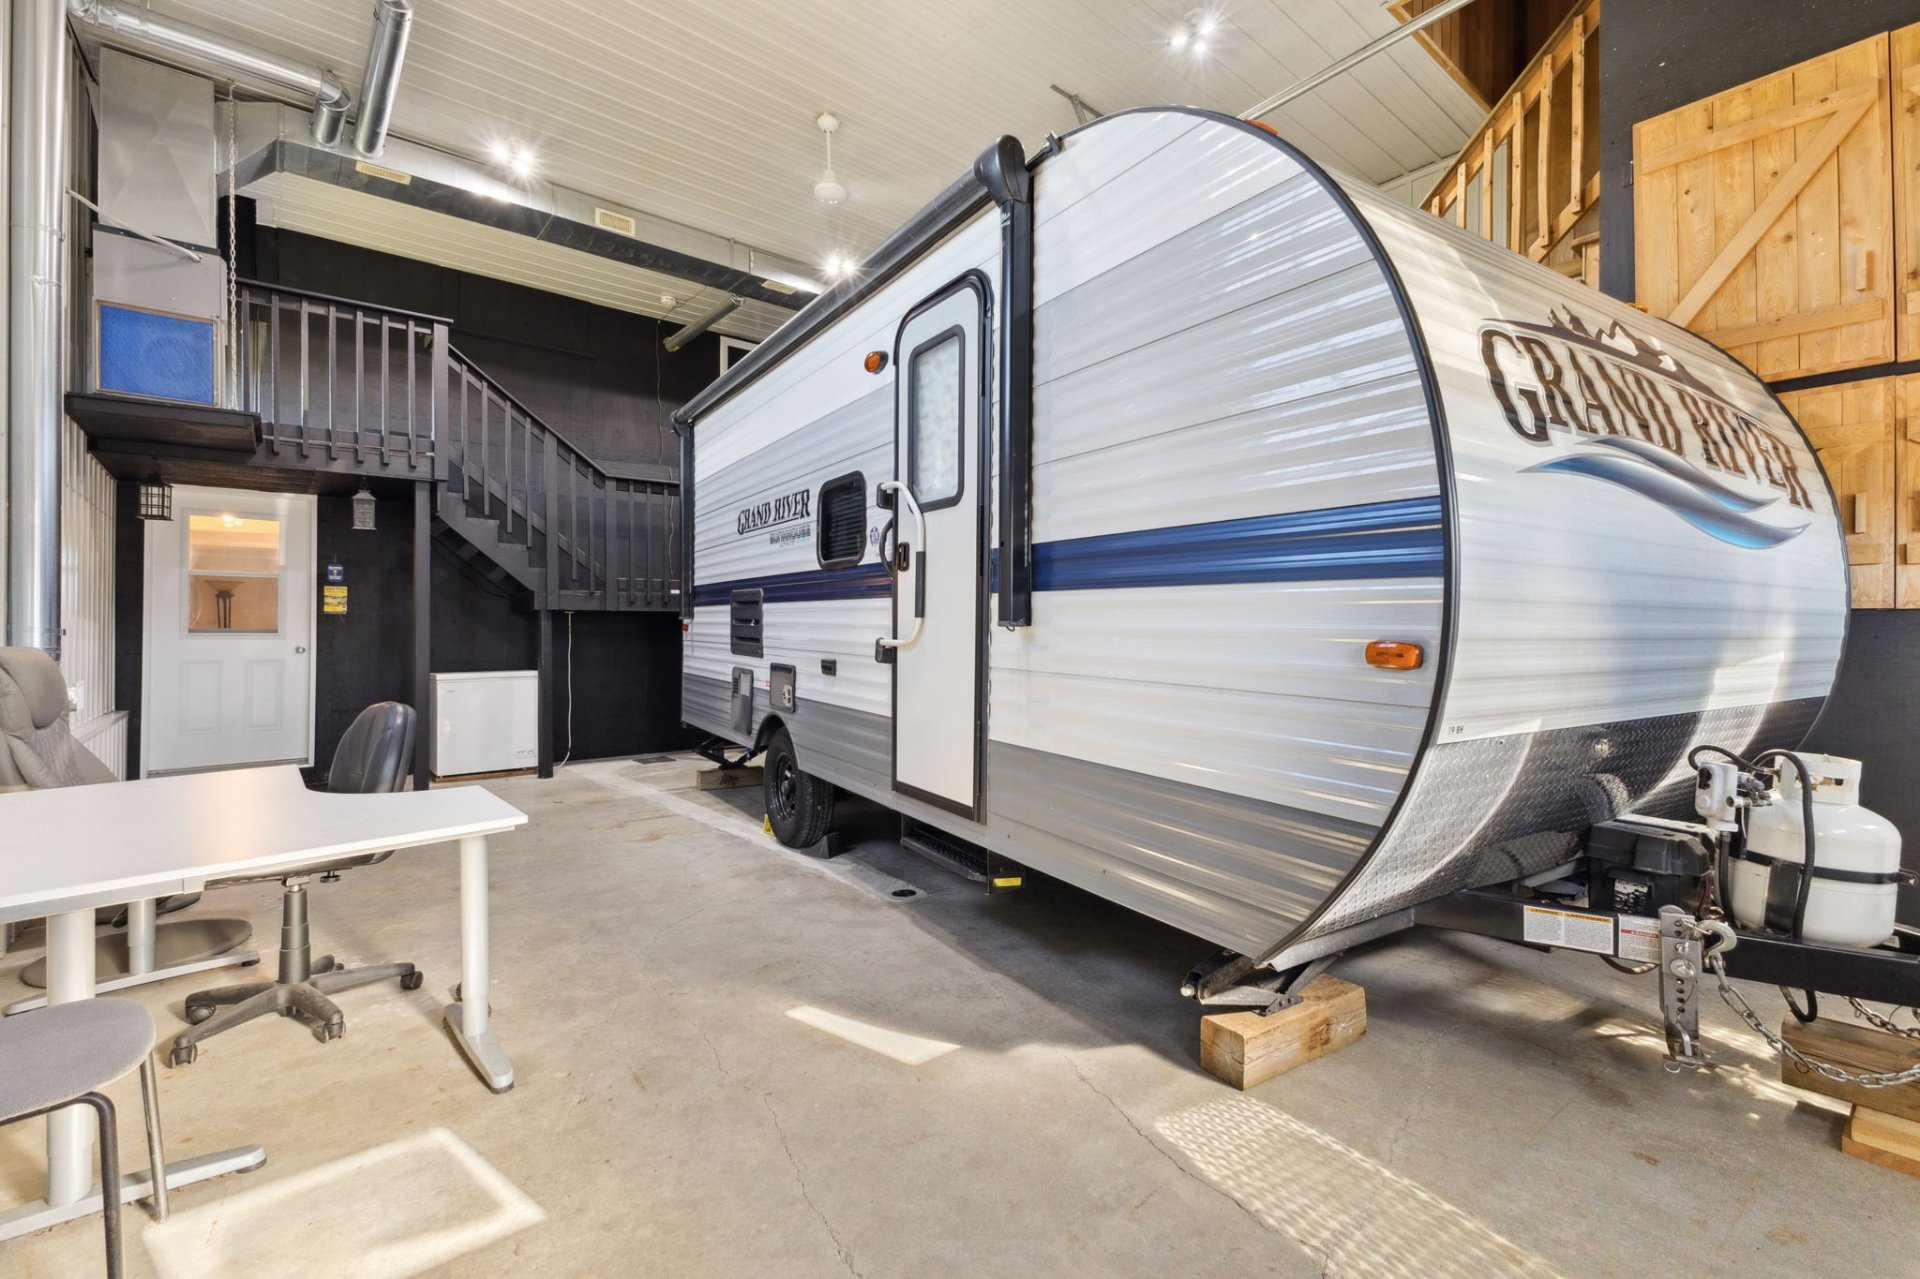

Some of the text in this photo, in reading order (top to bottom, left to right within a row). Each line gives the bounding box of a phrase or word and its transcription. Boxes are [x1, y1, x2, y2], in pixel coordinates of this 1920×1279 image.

[1479, 326, 1814, 512] GRAND RIVER
[737, 501, 772, 535] GRAND
[773, 489, 811, 522] RIVER
